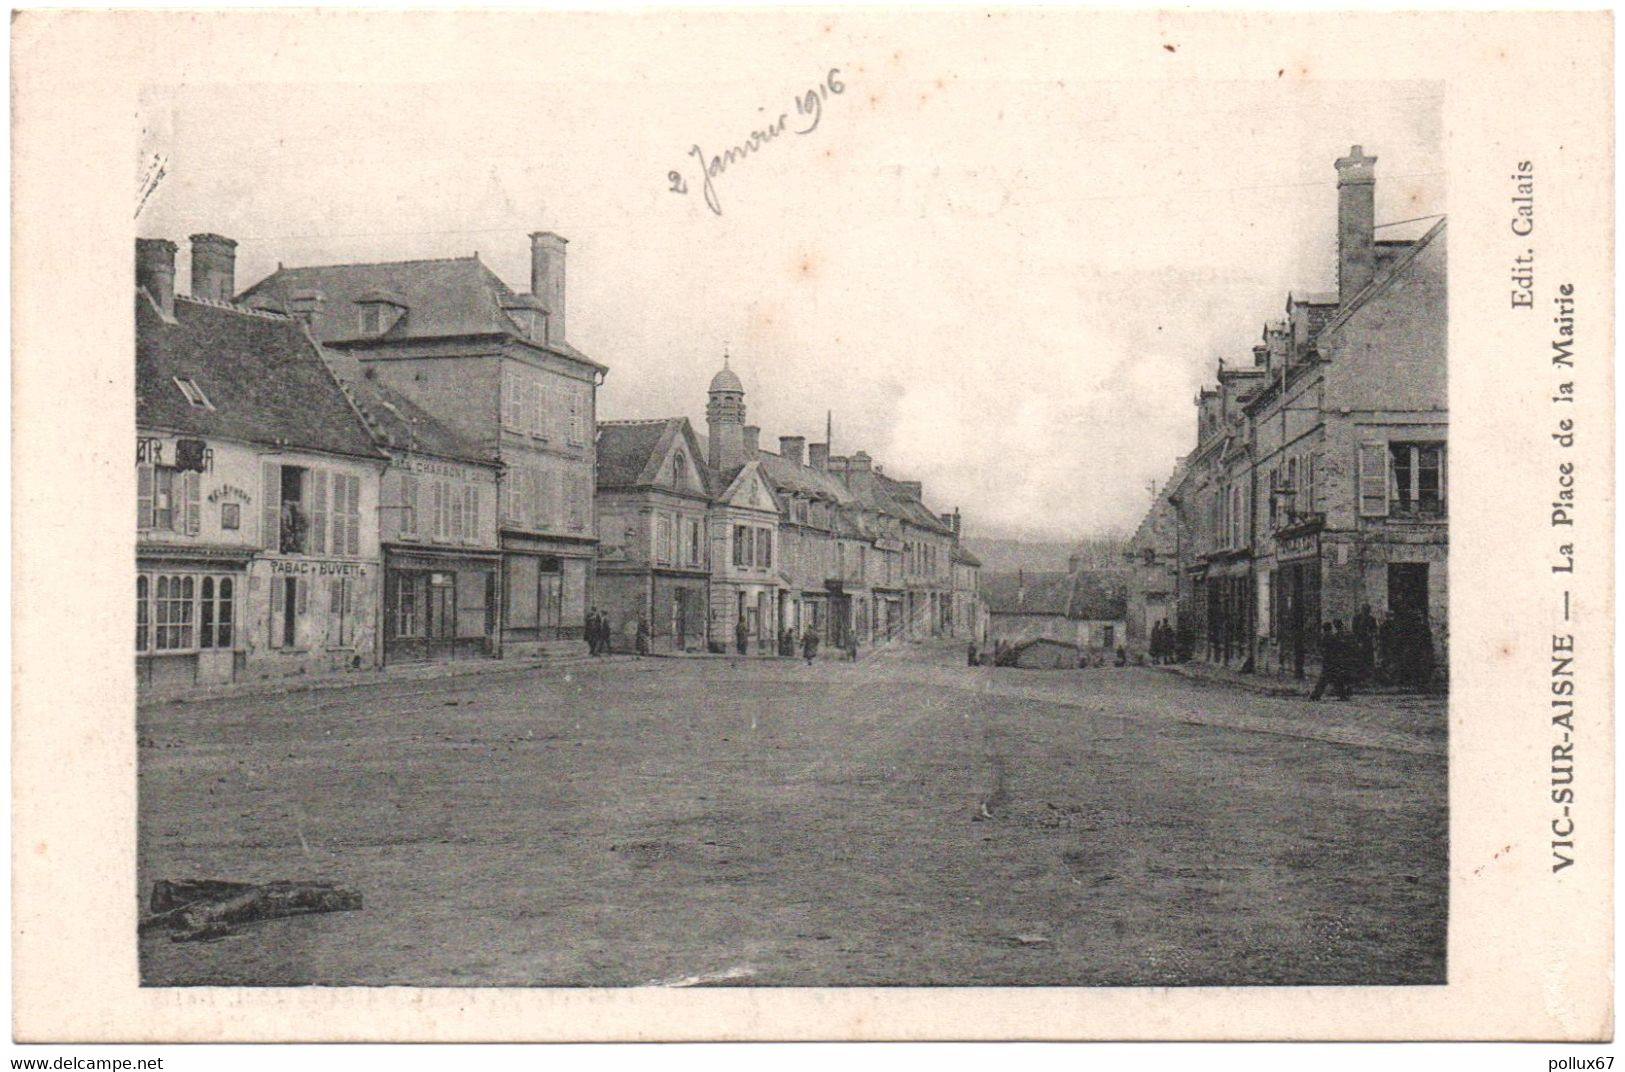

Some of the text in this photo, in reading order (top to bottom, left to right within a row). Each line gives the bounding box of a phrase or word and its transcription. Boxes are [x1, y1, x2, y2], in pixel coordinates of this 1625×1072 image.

[668, 67, 847, 216] 2 Janvier 1916
[1511, 160, 1534, 309] Edit. Calais
[270, 561, 368, 576] TABAC BUVETTE
[1551, 283, 1575, 874] VIC-SUR-AISNE La Place de la Mairie
